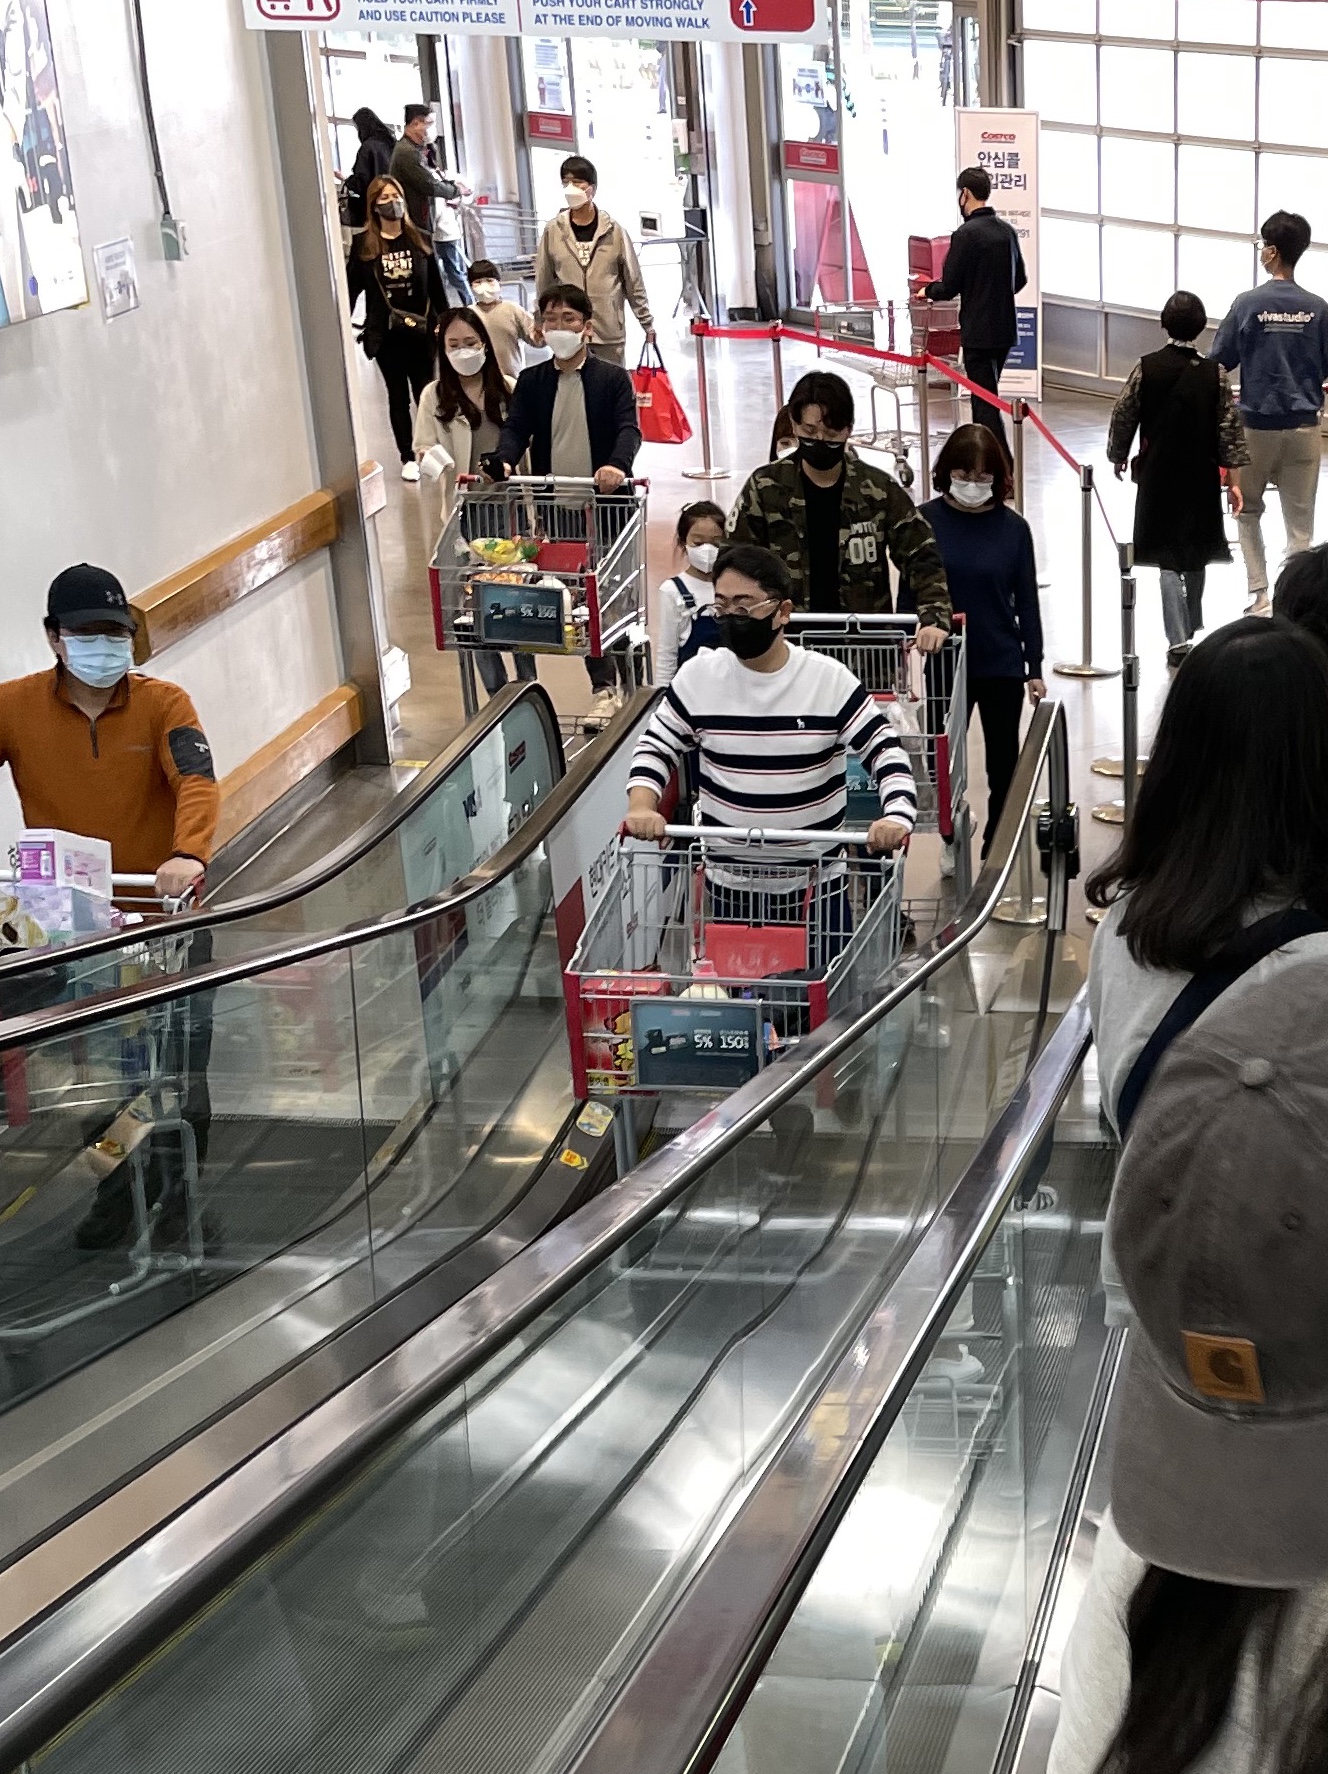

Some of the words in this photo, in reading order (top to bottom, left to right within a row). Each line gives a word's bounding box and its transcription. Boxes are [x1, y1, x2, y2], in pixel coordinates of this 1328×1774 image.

[358, 10, 381, 21] AND
[384, 10, 407, 22] USE
[410, 11, 459, 23] CAUTION
[462, 12, 506, 24] PLEASE
[534, 14, 549, 25] AT
[552, 14, 575, 26] THE
[578, 15, 603, 27] END
[606, 15, 623, 27] OF
[625, 15, 673, 28] MOVING
[675, 17, 711, 30] WALK
[977, 151, 1021, 169] 안심콜
[848, 535, 877, 565] 08
